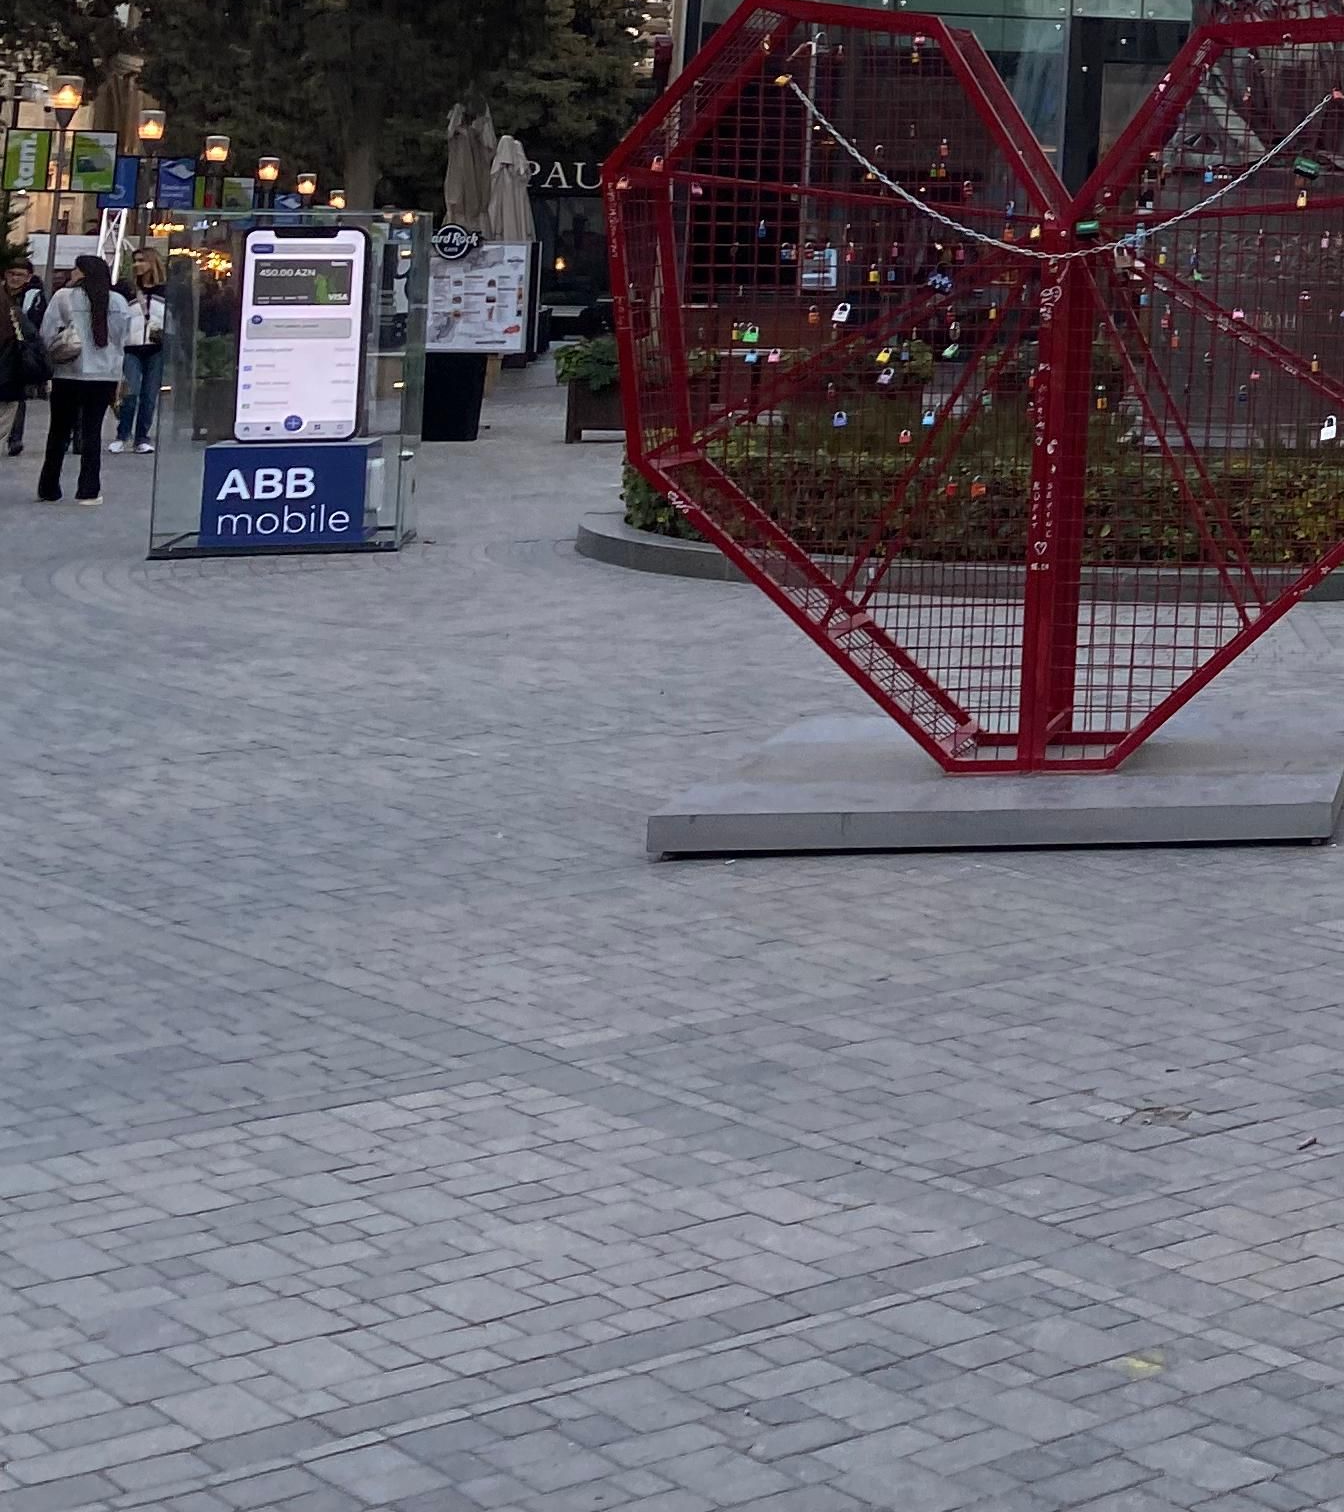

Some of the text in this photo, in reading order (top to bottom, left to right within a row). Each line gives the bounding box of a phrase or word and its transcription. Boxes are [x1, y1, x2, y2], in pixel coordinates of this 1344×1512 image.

[526, 160, 604, 189] PAU
[432, 232, 479, 247] ard Rock
[328, 293, 348, 301] VISA
[216, 467, 316, 500] ABB
[217, 504, 350, 535] mobile
